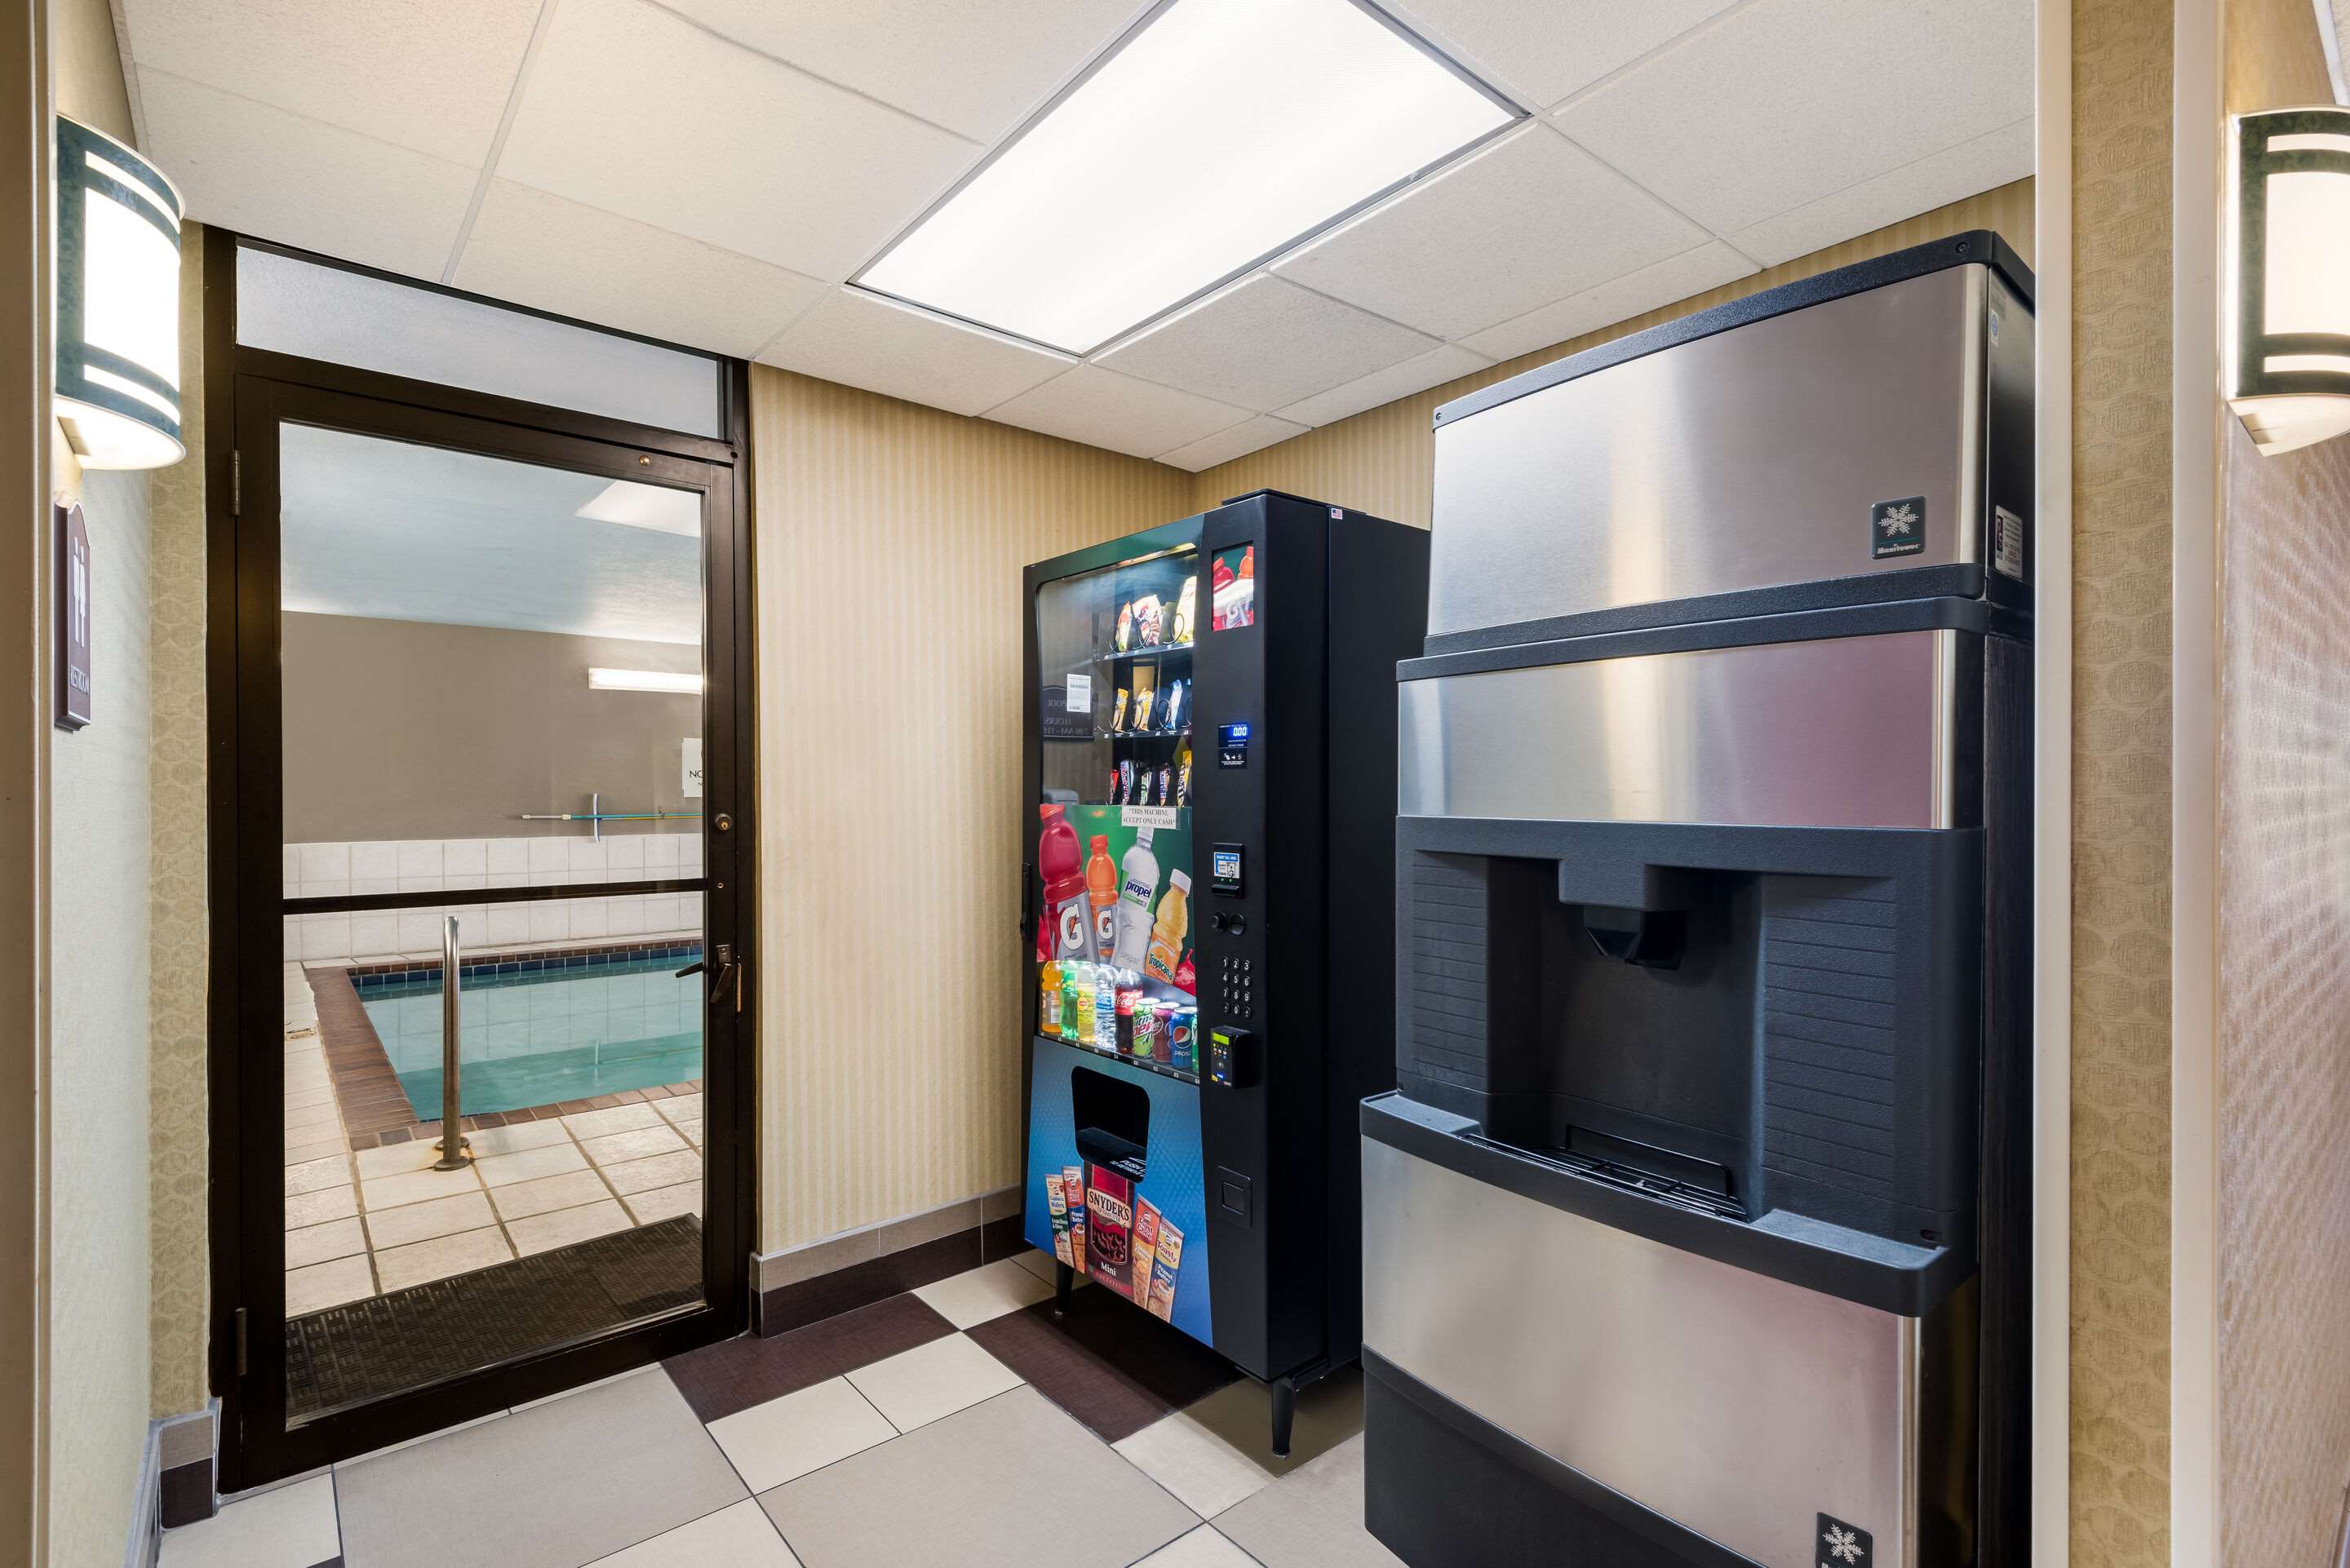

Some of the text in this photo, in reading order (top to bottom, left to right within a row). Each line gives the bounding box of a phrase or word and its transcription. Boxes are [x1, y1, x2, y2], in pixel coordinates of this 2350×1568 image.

[1125, 881, 1152, 898] propel
[1060, 904, 1084, 950] G
[1097, 910, 1114, 939] G
[1149, 953, 1173, 981] Tropicana
[1174, 1050, 1191, 1058] pepsi
[1120, 1160, 1143, 1170] PUSH
[1089, 1191, 1129, 1221] SNYDER'S
[1157, 1239, 1177, 1263] Toasty
[1101, 1260, 1117, 1277] Mini
